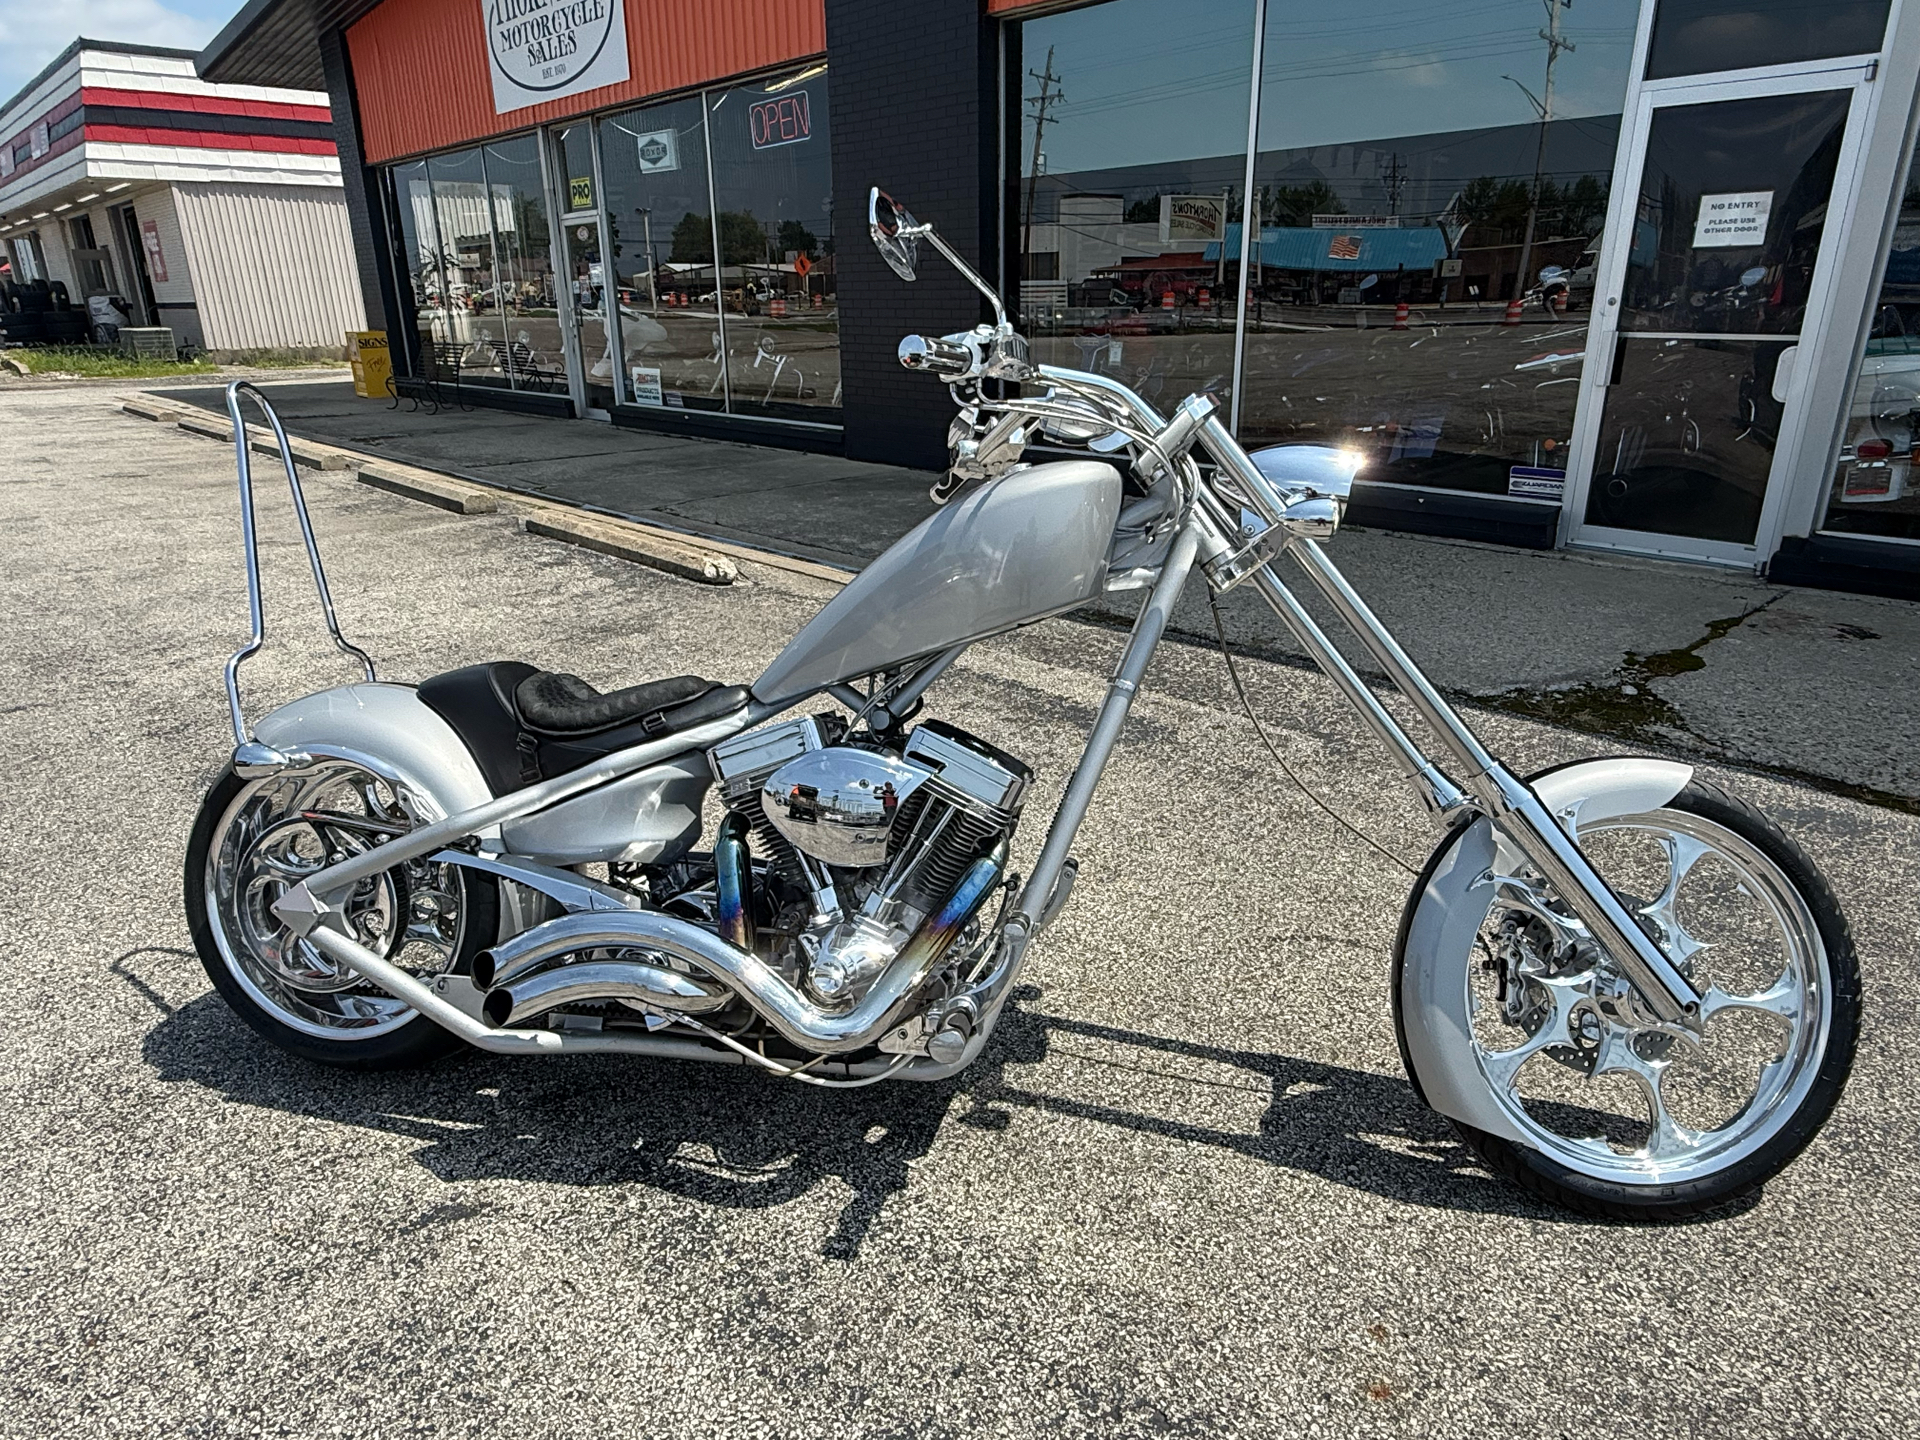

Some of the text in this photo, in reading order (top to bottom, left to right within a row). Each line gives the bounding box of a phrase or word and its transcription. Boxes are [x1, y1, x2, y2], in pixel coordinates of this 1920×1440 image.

[499, 0, 604, 52] MOTORCYCLE
[527, 30, 578, 67] SALES
[753, 98, 808, 144] OPEN
[572, 183, 590, 200] PRO
[1710, 201, 1761, 211] NO ENTRY
[1708, 218, 1739, 226] PLEASE
[358, 337, 388, 348] SIGNS
